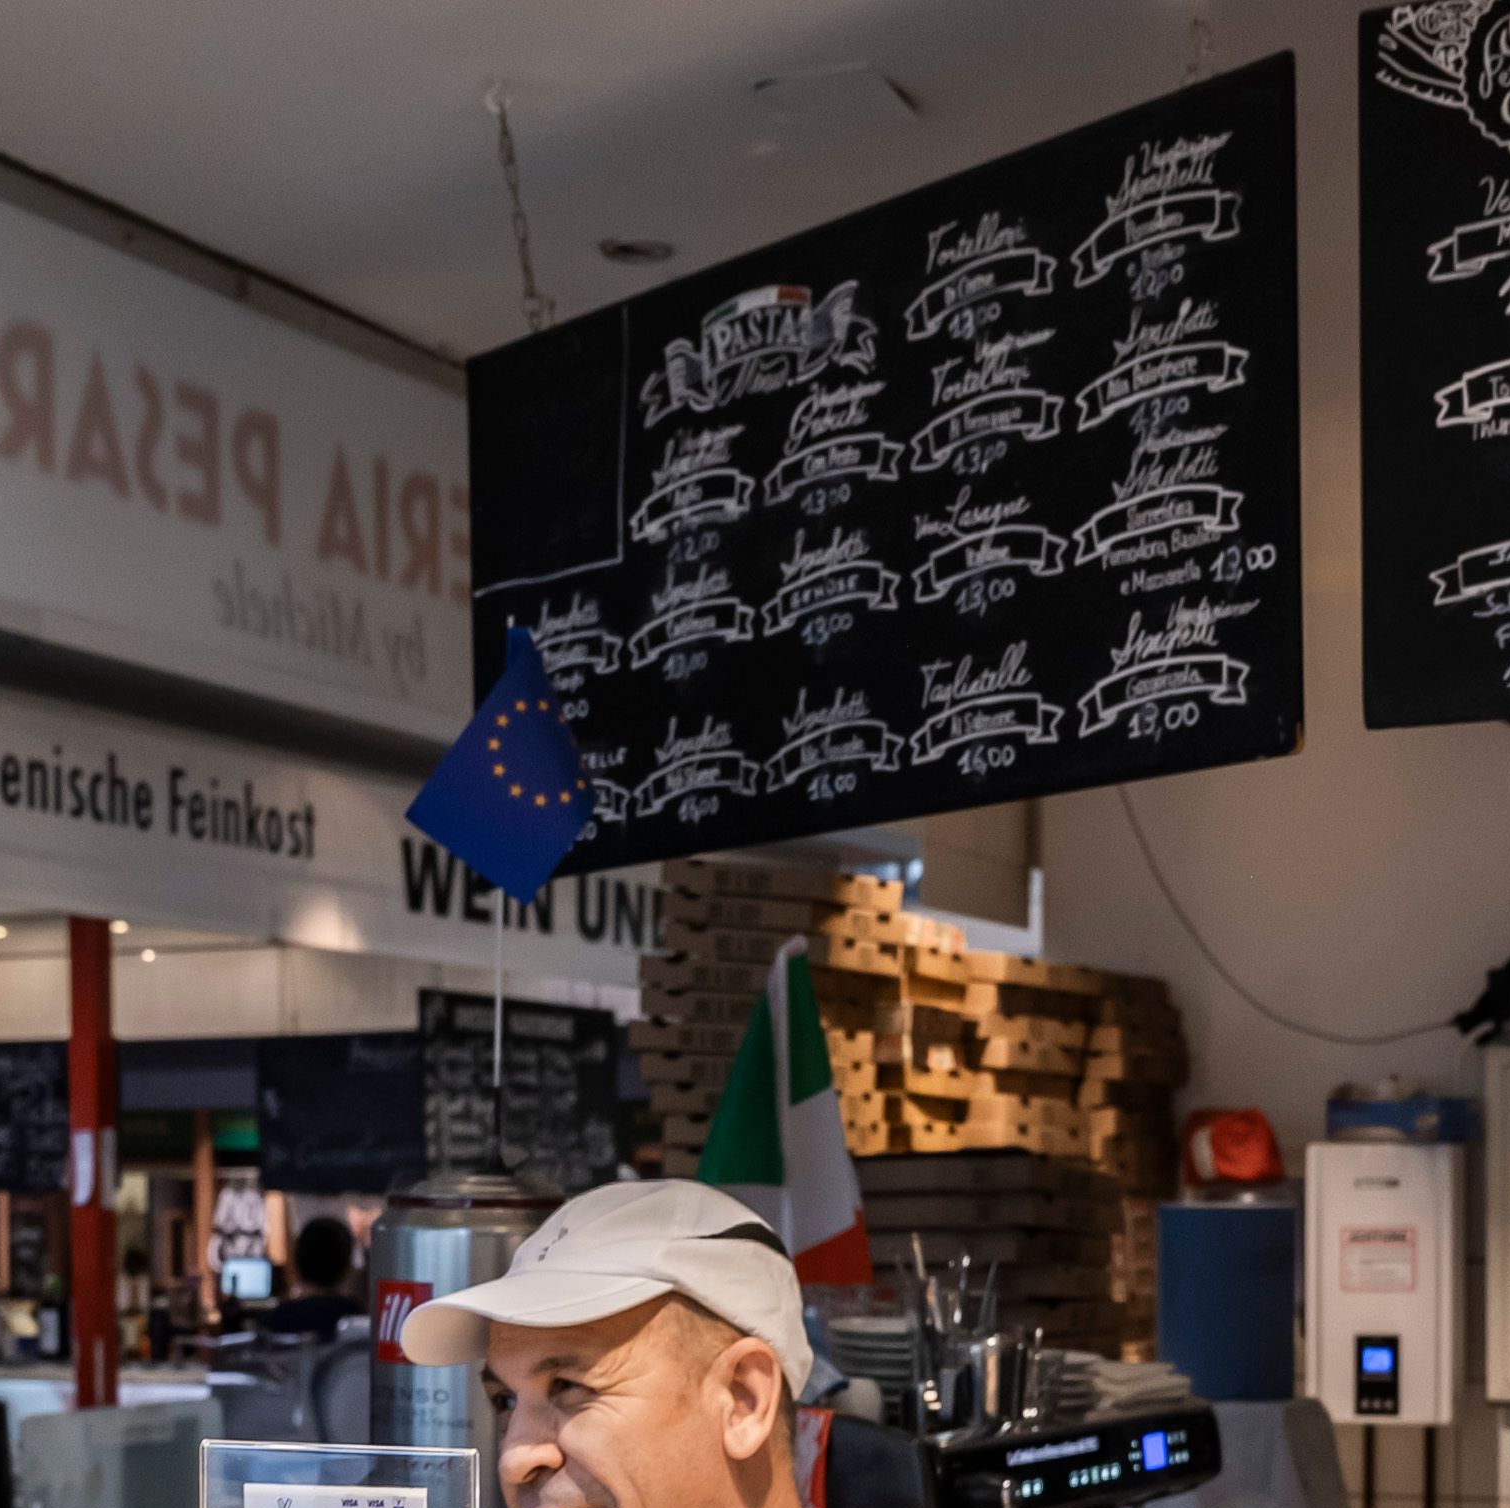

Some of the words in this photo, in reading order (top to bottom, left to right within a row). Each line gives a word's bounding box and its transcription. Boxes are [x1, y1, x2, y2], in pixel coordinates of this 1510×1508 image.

[921, 641, 1033, 712] Tagliatelle
[1128, 702, 1199, 741] 13,00
[168, 765, 318, 861] Feinkost
[379, 1291, 411, 1344] ill
[341, 1499, 359, 1508] VISA
[367, 1499, 385, 1508] VISA
